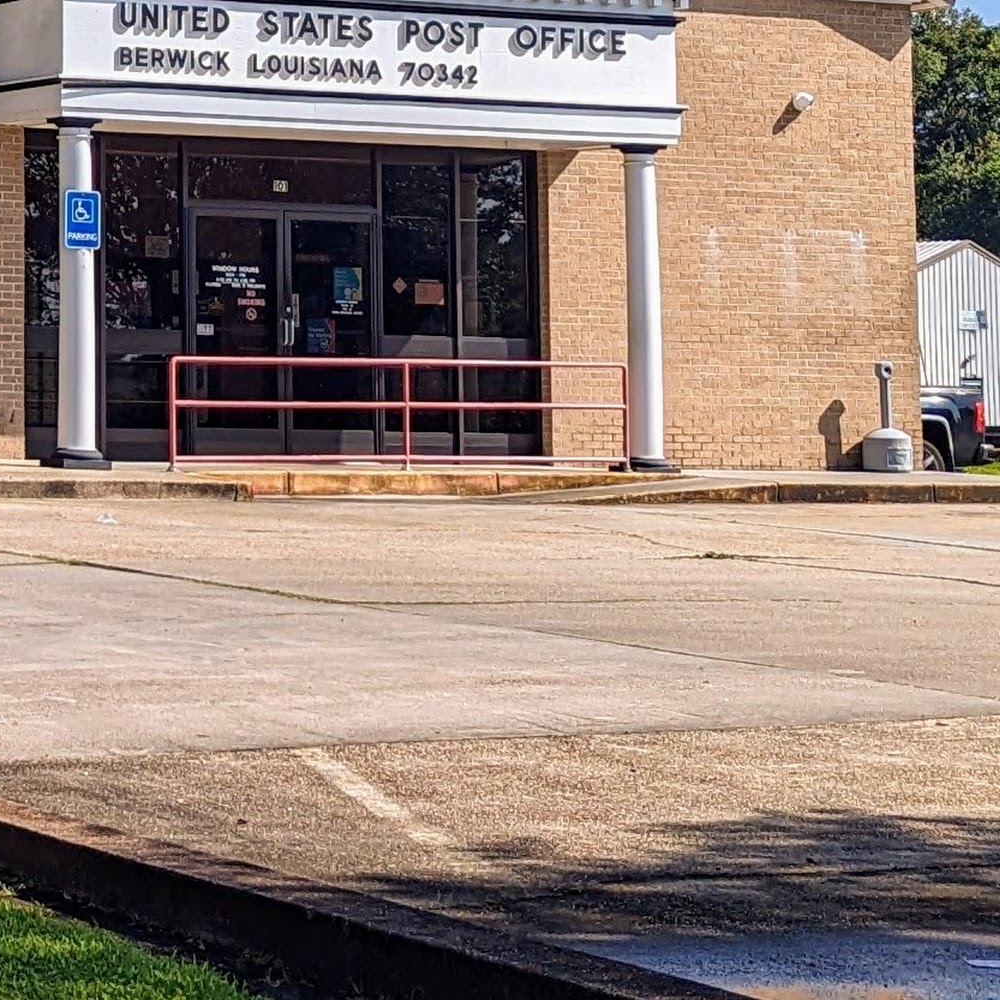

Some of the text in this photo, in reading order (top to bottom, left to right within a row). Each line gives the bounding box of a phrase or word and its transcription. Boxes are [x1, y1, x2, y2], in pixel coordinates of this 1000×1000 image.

[118, 2, 627, 56] UNITED STATES POST OFFICE
[117, 46, 478, 85] BERWICK LOUISIANA 70342
[67, 231, 98, 242] PARKING
